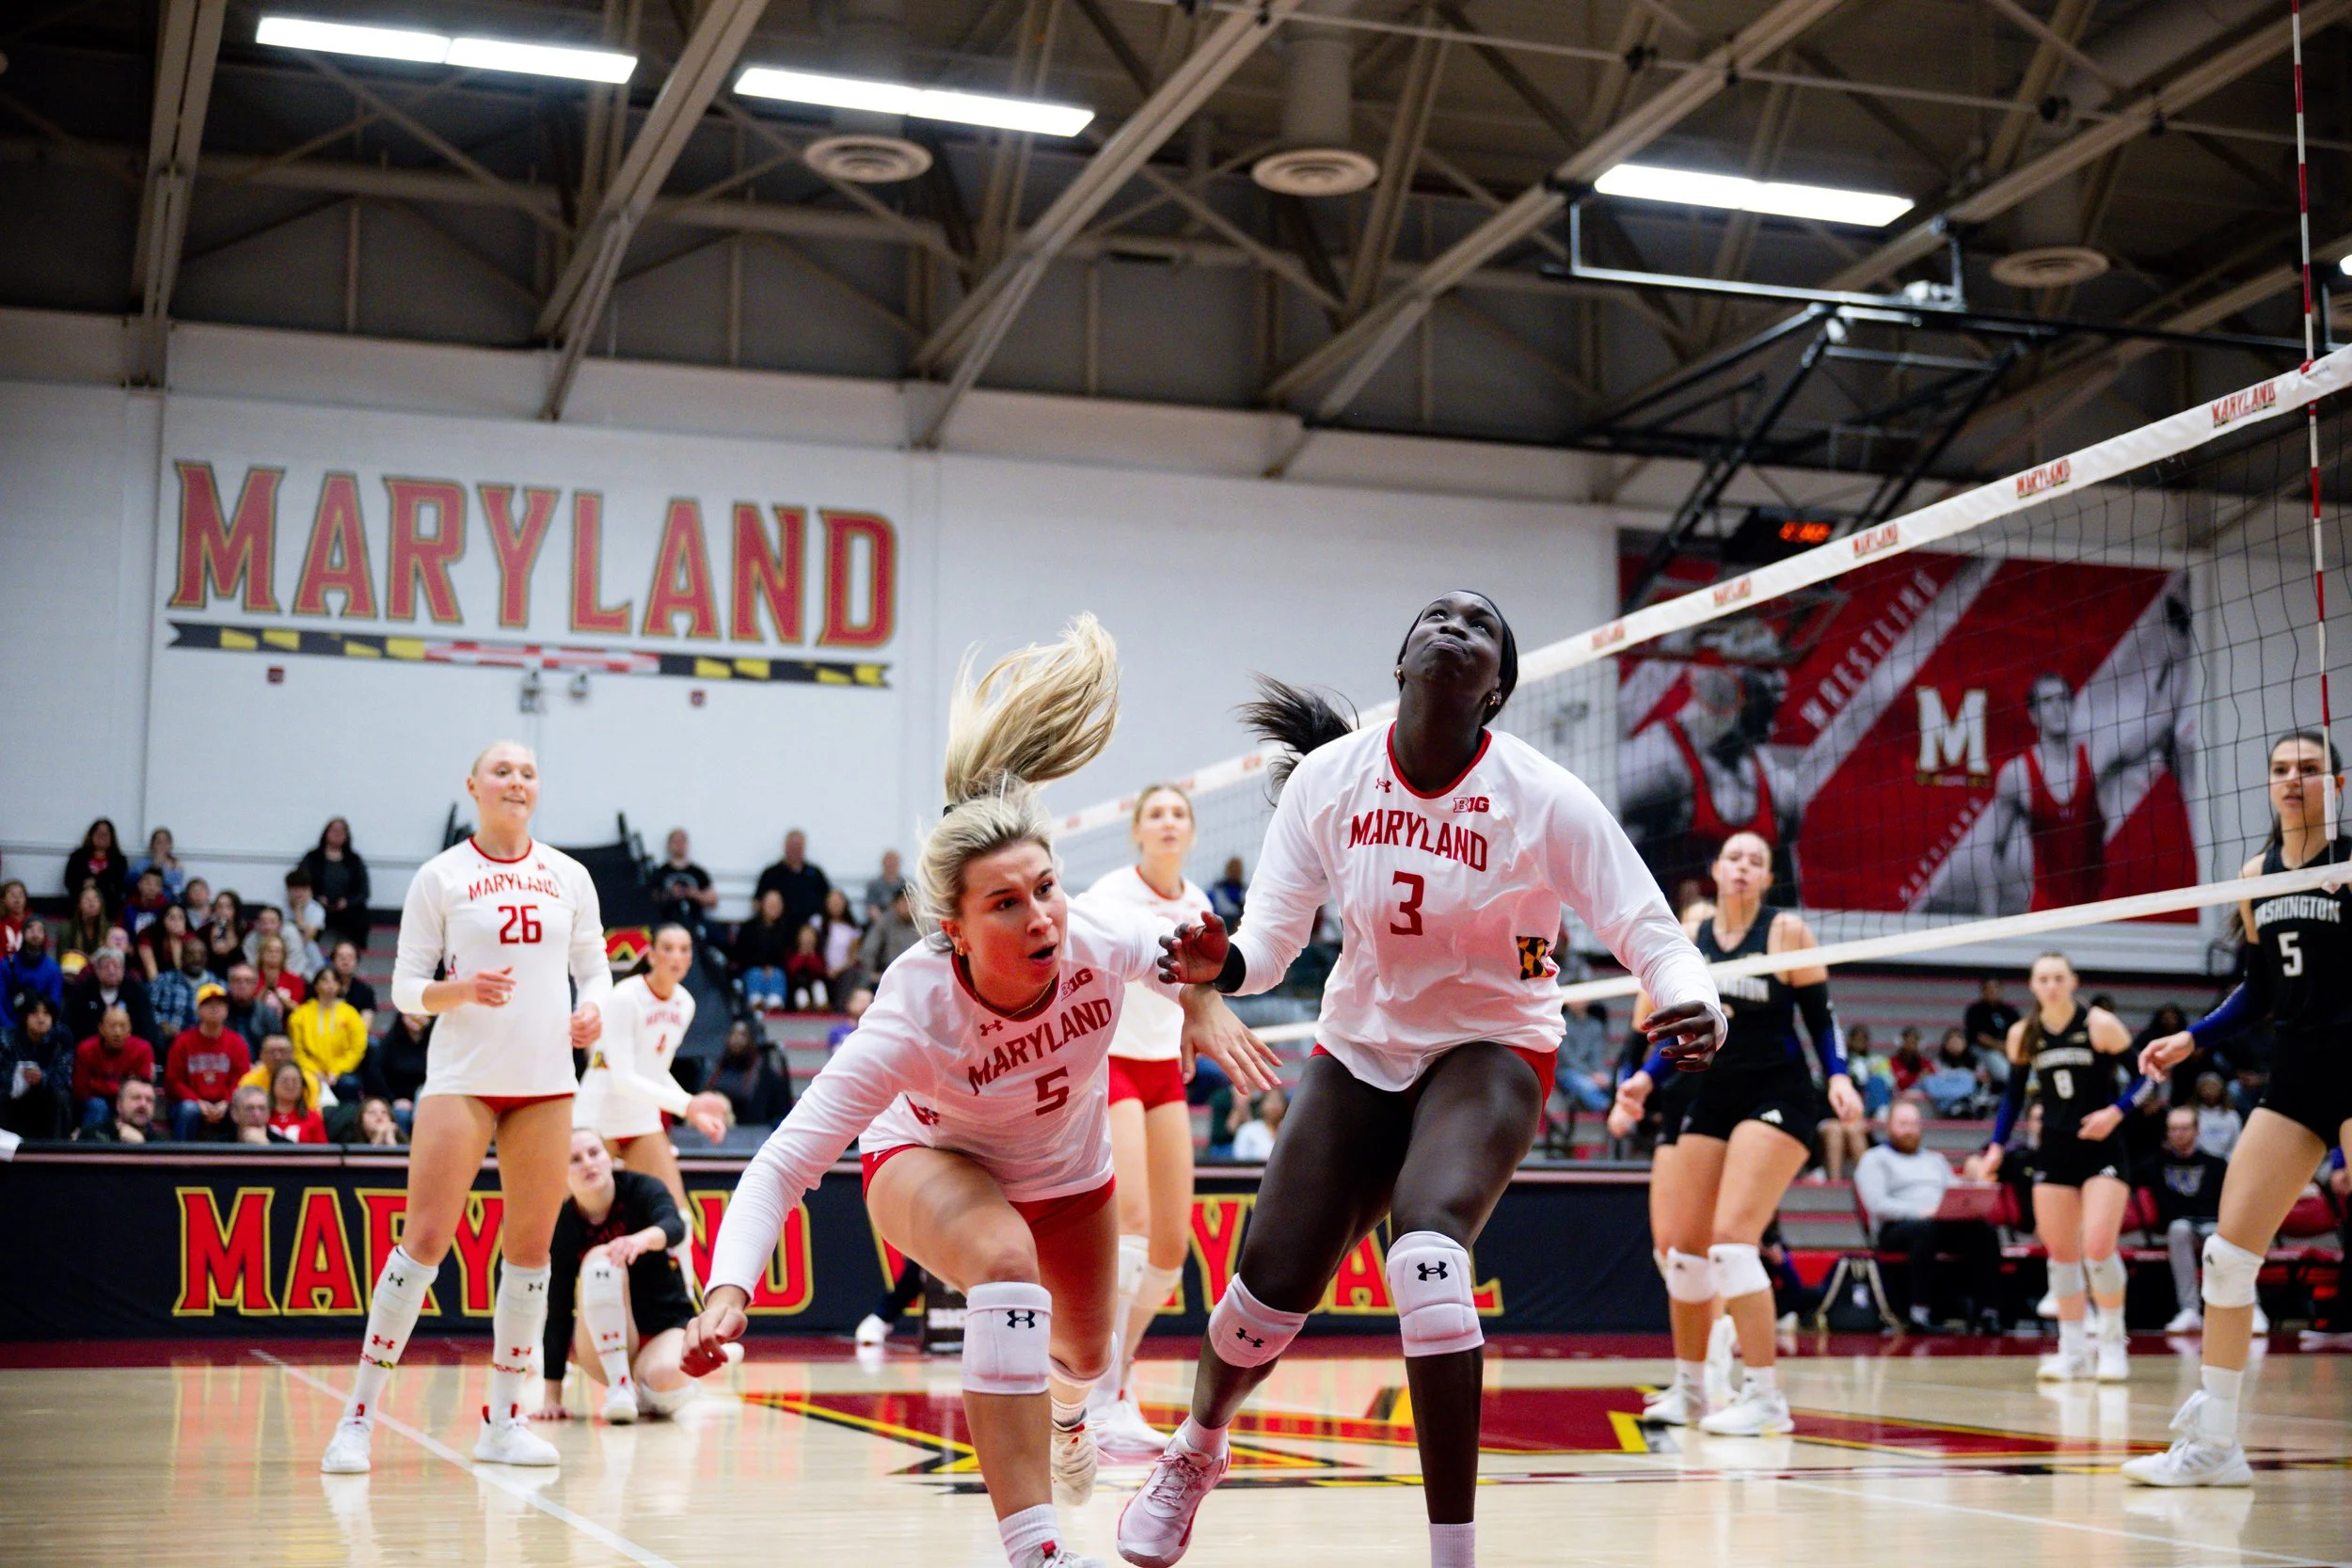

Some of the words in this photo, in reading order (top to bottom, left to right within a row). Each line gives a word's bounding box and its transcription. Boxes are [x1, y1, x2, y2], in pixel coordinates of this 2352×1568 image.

[2212, 380, 2277, 423] MARYLAND
[167, 458, 899, 650] MARYLAND
[1799, 568, 1939, 730] WRESTLING
[1915, 686, 1991, 776] M
[1347, 808, 1488, 873] MARYLAND
[468, 872, 560, 902] MARYLAND
[1390, 870, 1425, 936] 3
[498, 904, 543, 945] 26
[2278, 930, 2304, 977] 5
[967, 997, 1113, 1097] MARYLAND
[1035, 1065, 1070, 1117] 5
